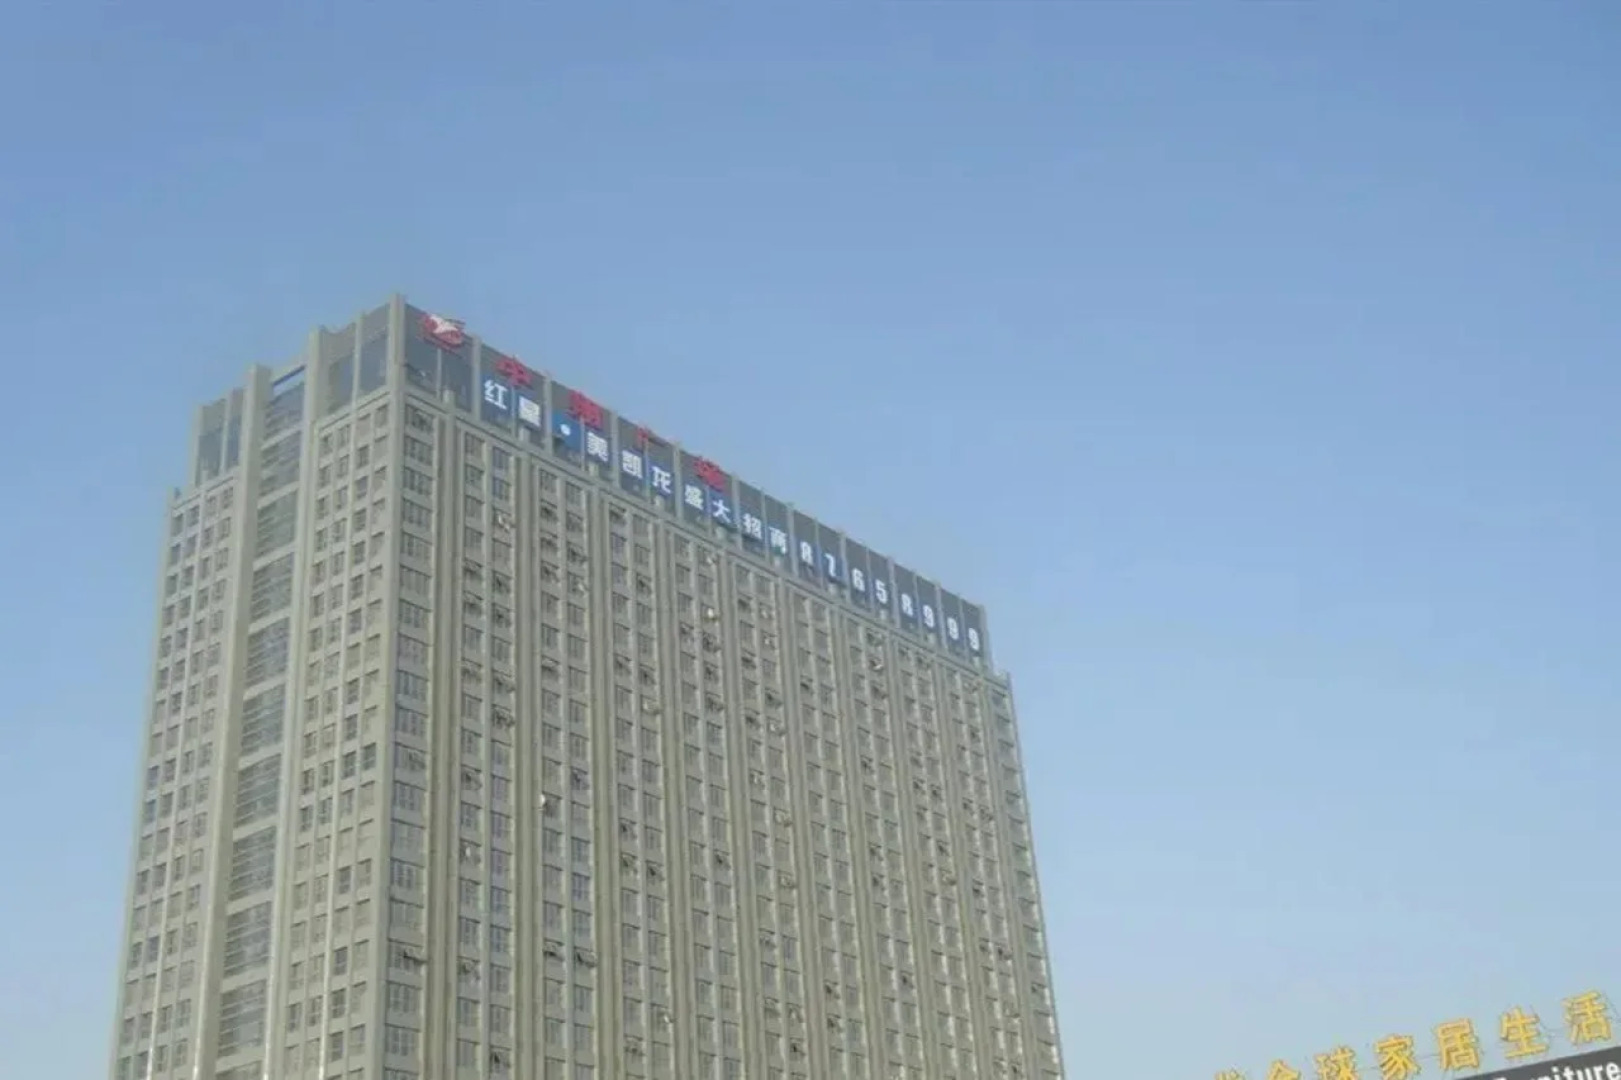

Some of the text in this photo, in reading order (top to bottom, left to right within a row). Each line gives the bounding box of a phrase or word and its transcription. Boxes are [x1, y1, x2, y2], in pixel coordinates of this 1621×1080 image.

[1215, 990, 1612, 1080] 球家居生活
[1492, 1061, 1621, 1080] iture
